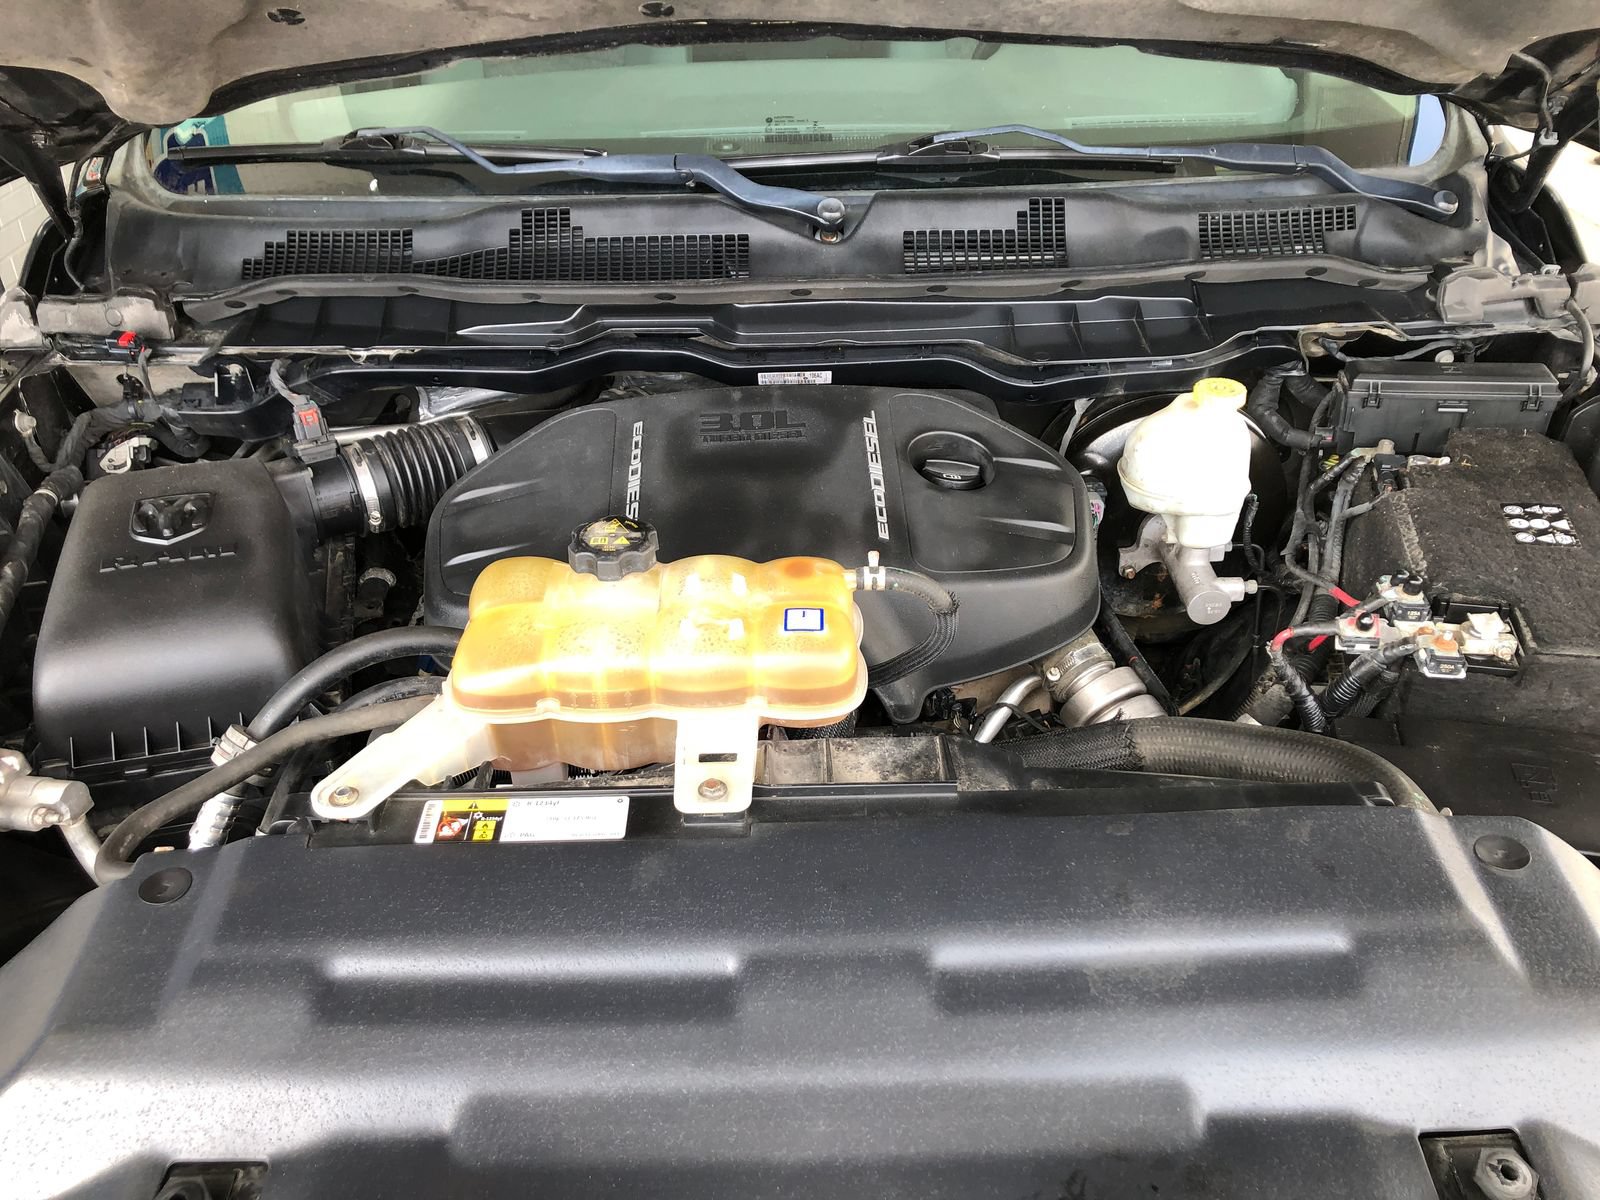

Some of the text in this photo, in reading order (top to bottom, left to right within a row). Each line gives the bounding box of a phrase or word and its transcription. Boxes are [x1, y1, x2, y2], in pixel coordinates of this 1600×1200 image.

[626, 420, 643, 521] ECODIES
[699, 410, 806, 431] 3.0L
[863, 410, 889, 540] ECODIESEL
